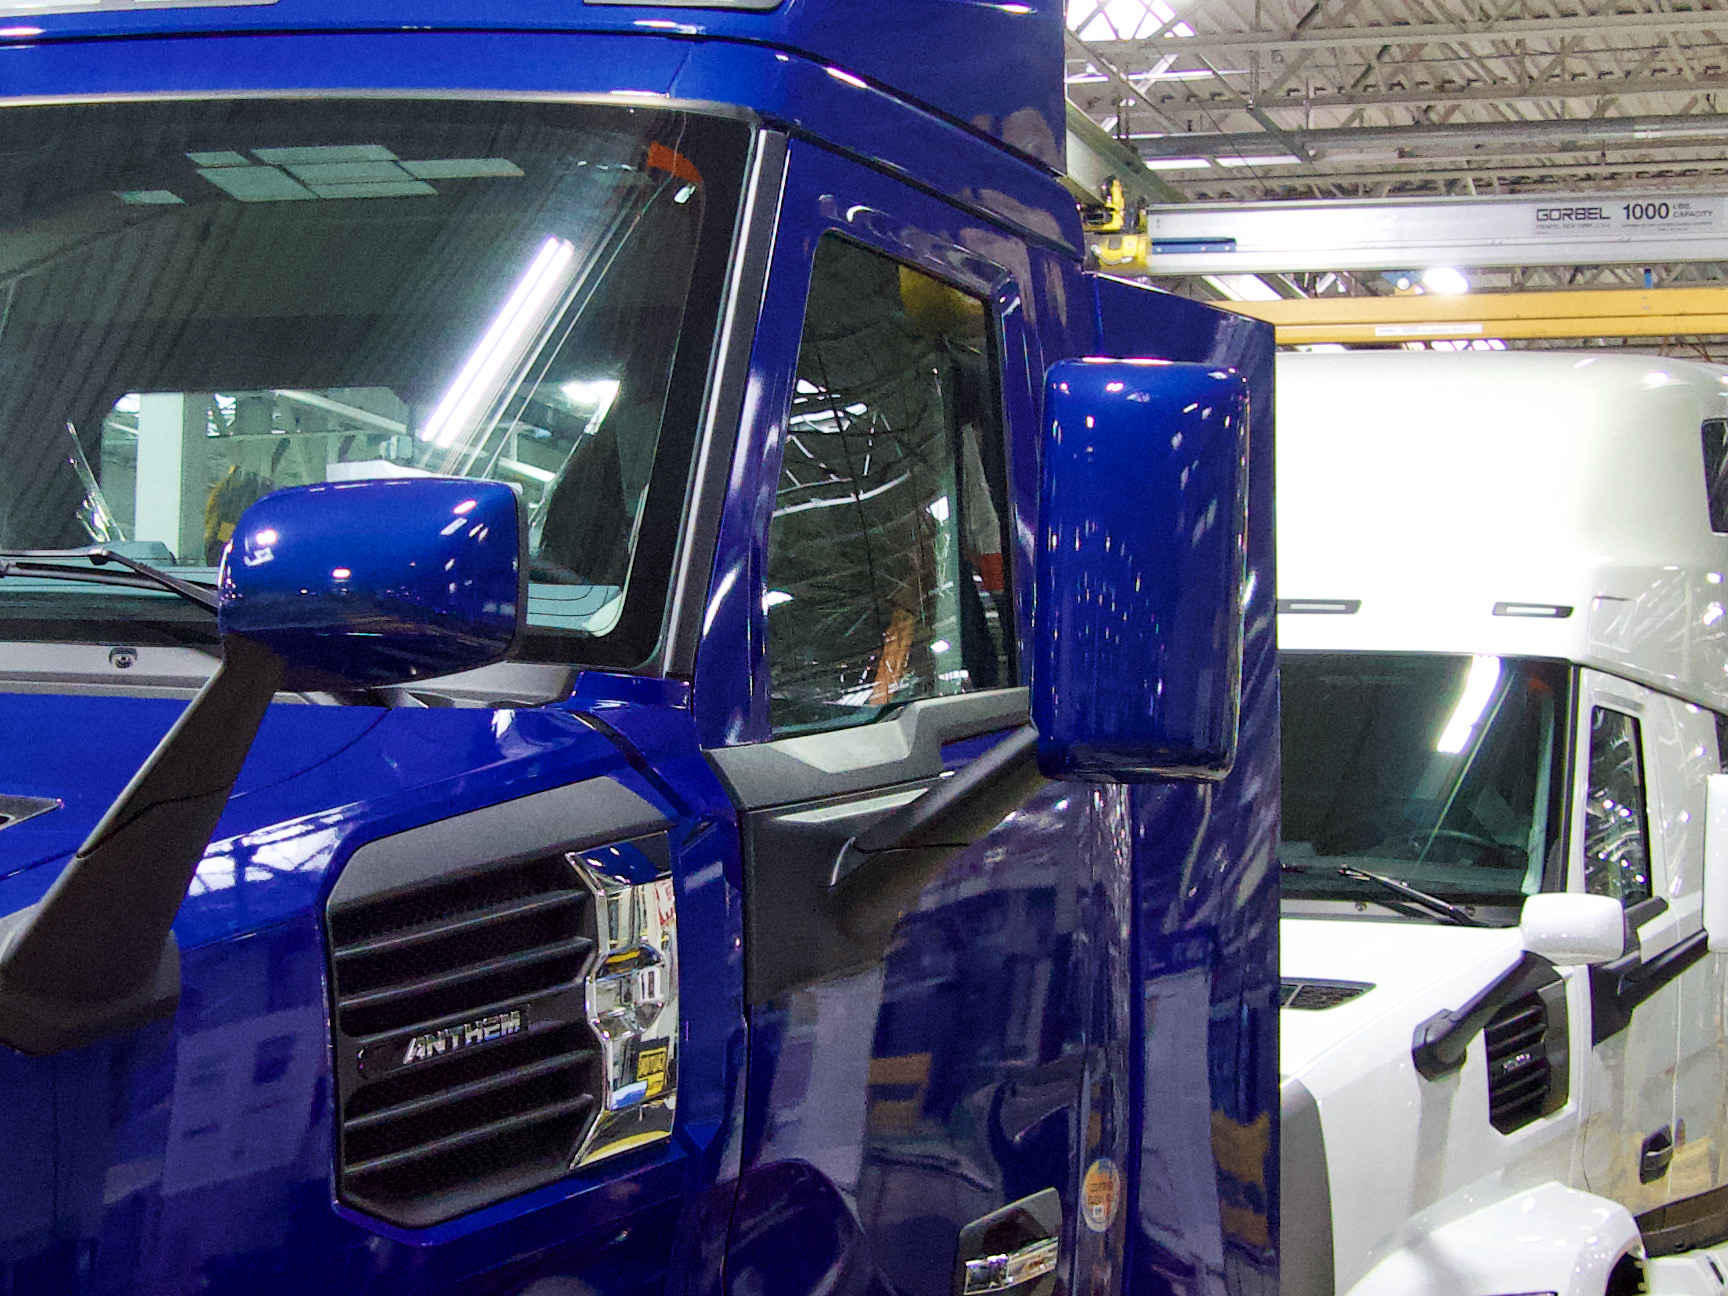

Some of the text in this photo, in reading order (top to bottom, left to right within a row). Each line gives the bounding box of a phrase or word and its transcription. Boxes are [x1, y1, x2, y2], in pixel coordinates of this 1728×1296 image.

[1536, 202, 1670, 222] GORBEL 1000
[402, 1010, 521, 1065] ANTHEM
